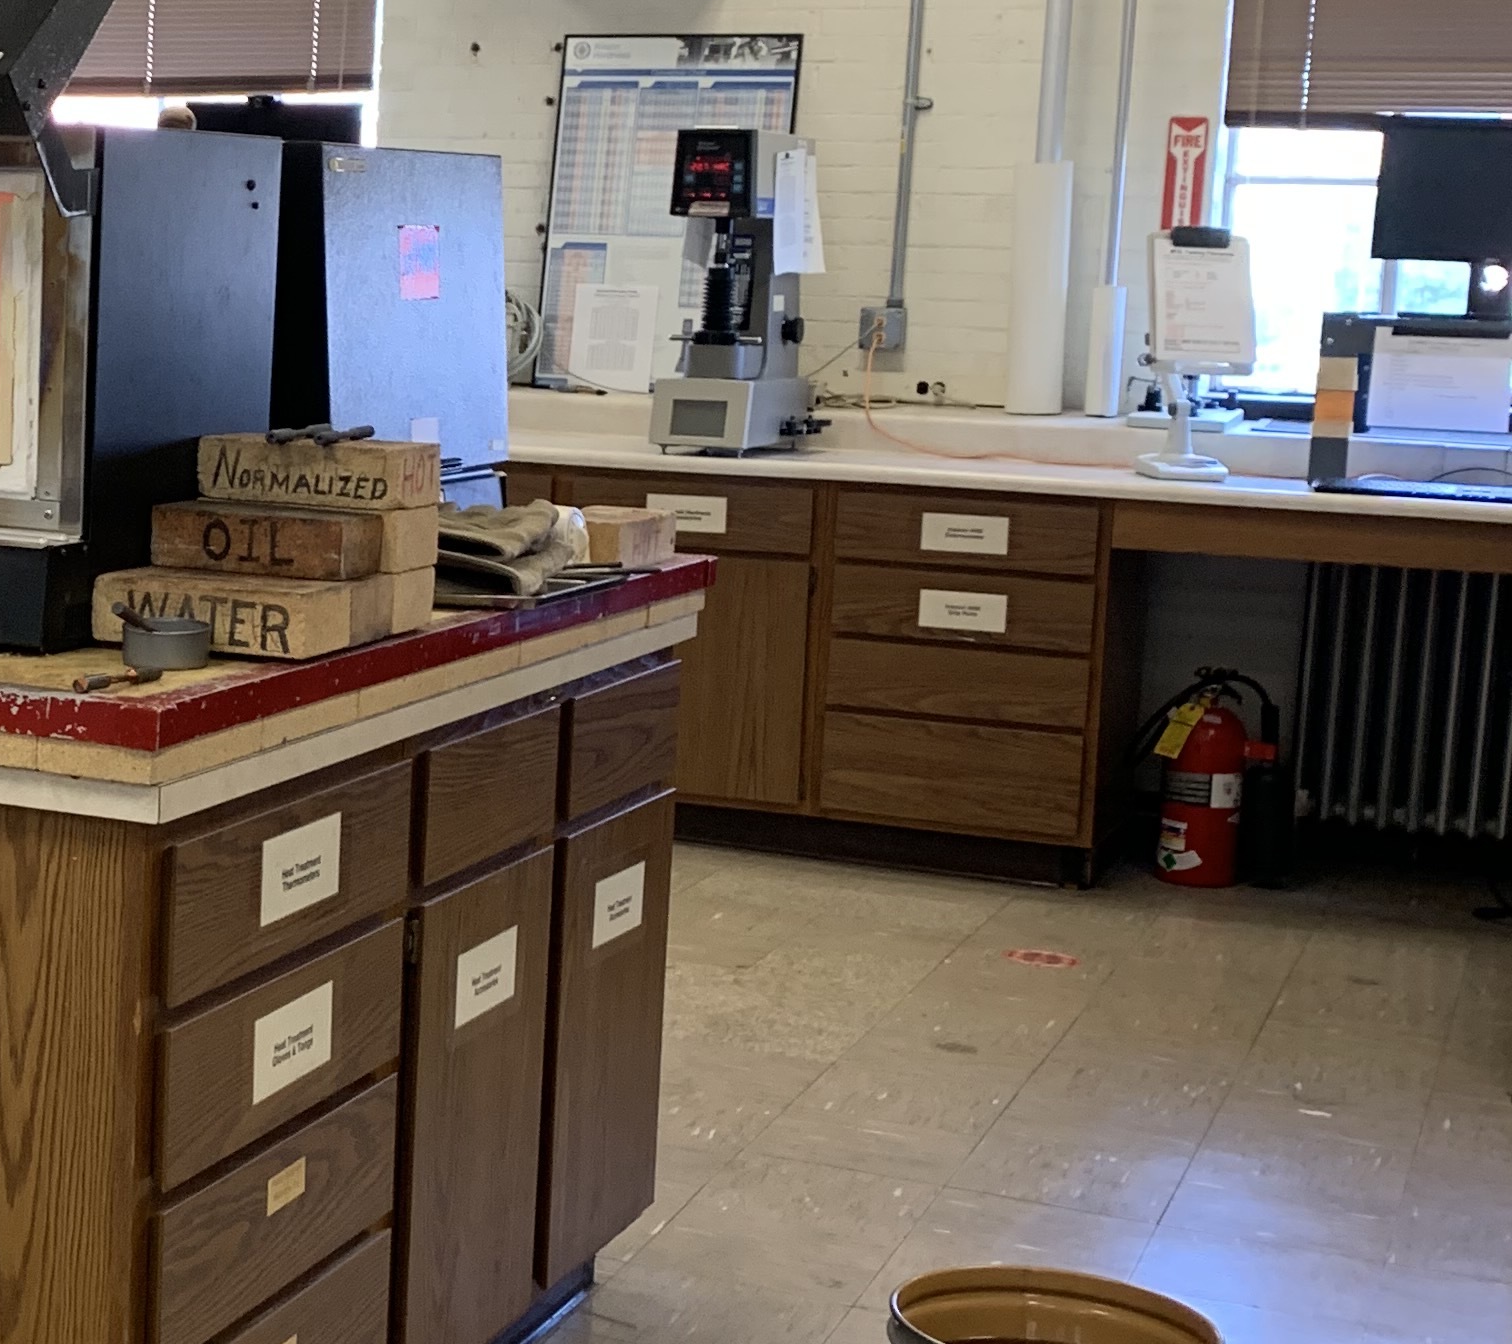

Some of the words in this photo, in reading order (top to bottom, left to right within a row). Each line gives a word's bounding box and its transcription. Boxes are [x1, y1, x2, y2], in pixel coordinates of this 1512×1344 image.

[1174, 134, 1202, 148] FIRE
[1178, 150, 1190, 227] EXTINGUIS
[212, 444, 388, 501] NORMALIZED
[203, 520, 294, 564] OIL
[282, 867, 294, 879] Heat
[295, 855, 321, 873] Treatment
[482, 964, 502, 981] Treatment
[273, 1039, 287, 1054] Heat
[288, 1024, 313, 1047] Treatment
